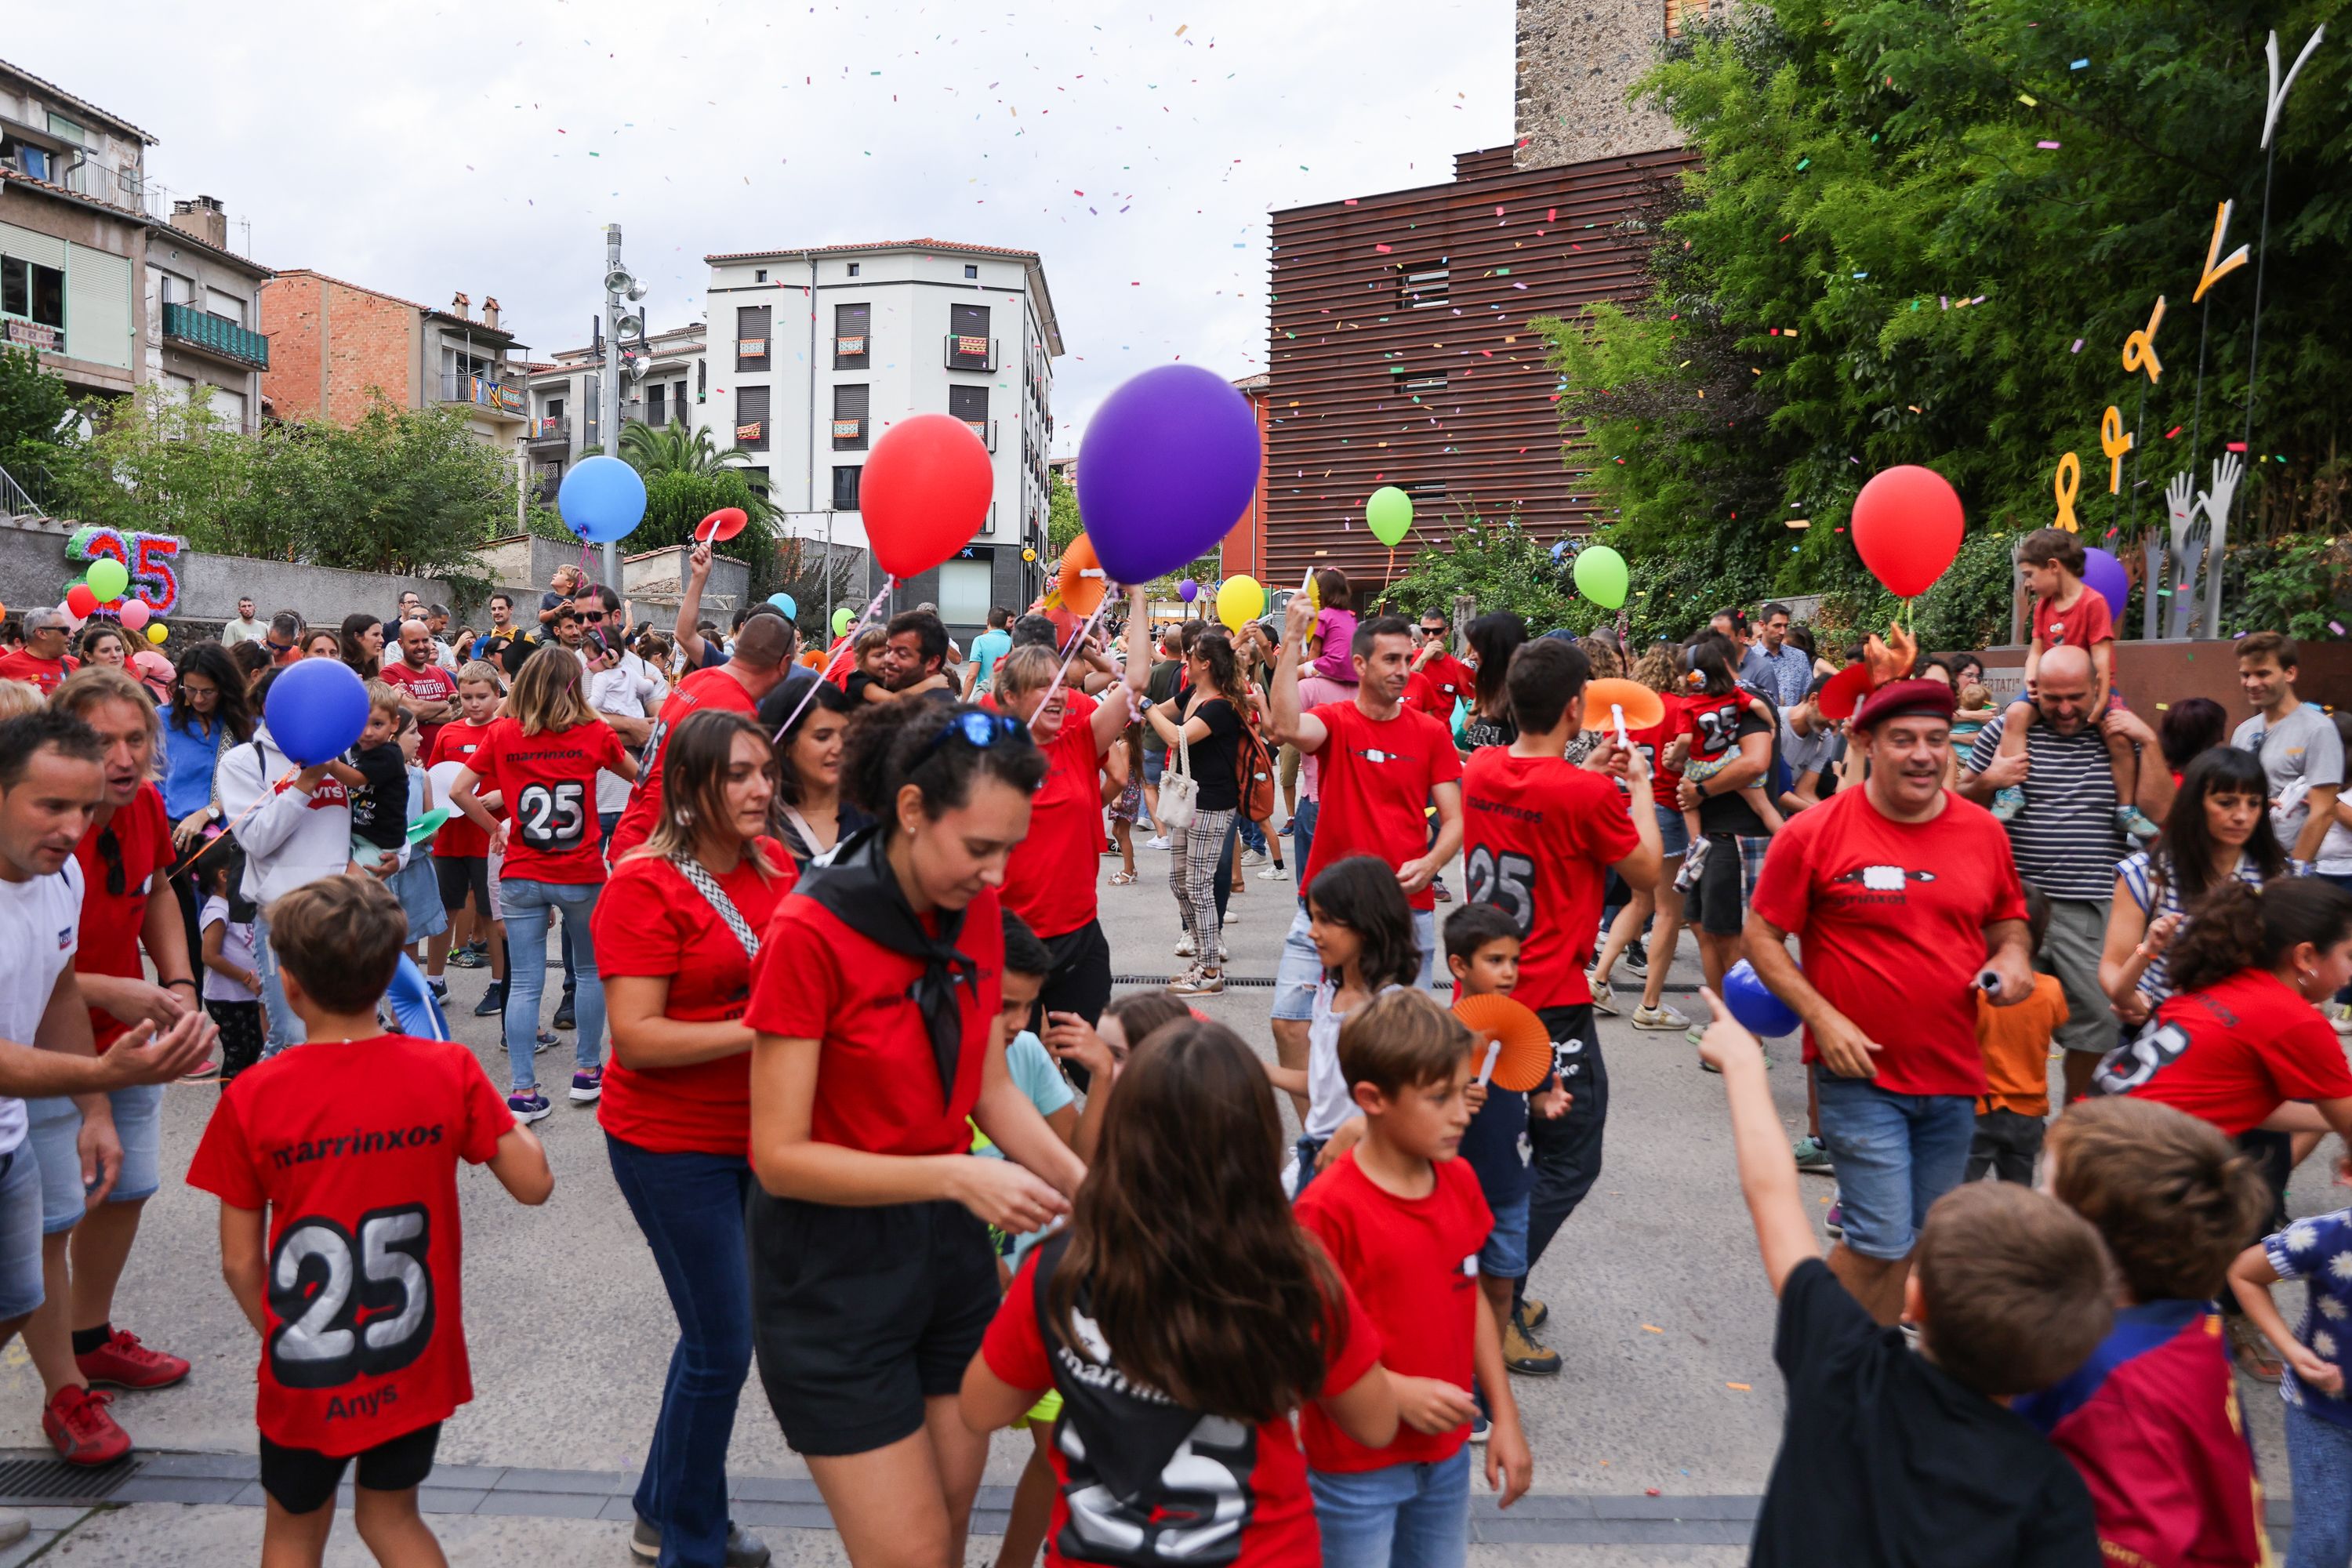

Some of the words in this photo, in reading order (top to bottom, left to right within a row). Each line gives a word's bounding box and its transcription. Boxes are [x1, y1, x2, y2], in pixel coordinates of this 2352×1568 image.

[506, 748, 584, 763] marrinxos
[518, 784, 585, 847] 25
[272, 1207, 433, 1374] 25
[325, 1384, 398, 1421] Anys
